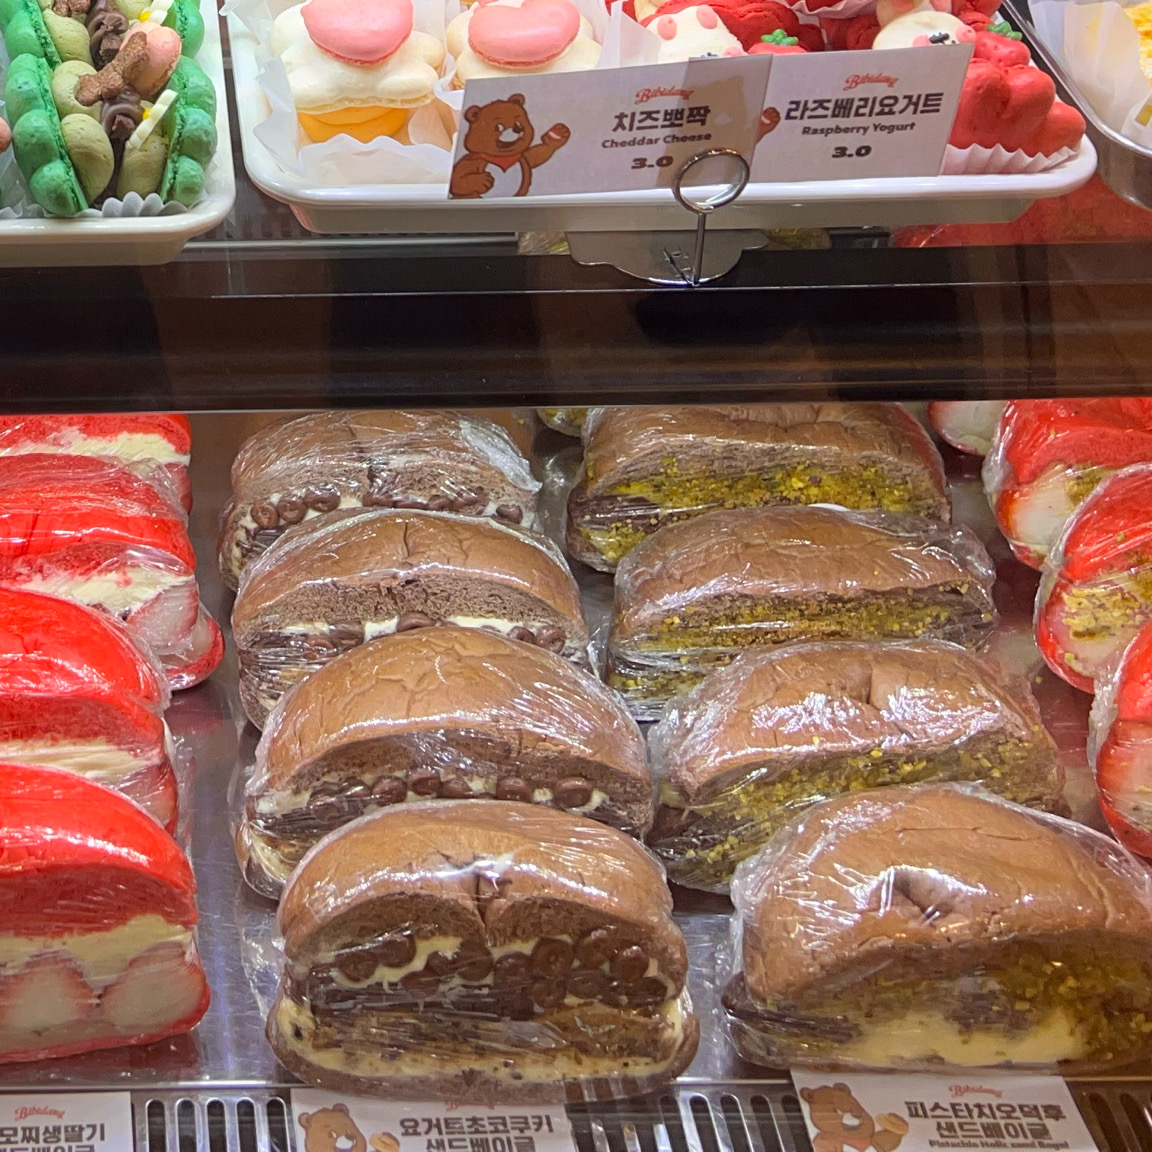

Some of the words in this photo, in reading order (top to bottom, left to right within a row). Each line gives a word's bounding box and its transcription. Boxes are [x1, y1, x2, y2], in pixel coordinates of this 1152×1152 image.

[842, 71, 900, 91] Bibidang
[634, 85, 695, 105] Bibidang
[784, 92, 944, 121] 라즈베리요거트
[612, 105, 711, 132] 치즈뽀짝
[802, 123, 870, 137] Raspberry
[872, 121, 917, 135] Yogurt
[601, 136, 660, 149] Cheddar
[662, 132, 712, 144] Cheese
[831, 145, 873, 158] 3.0
[631, 155, 674, 169] 3.0
[904, 1101, 1067, 1122] 피스타치오덕후
[400, 1114, 554, 1136] 요거트초코쿠키
[935, 1121, 1053, 1140] 샌드베이글
